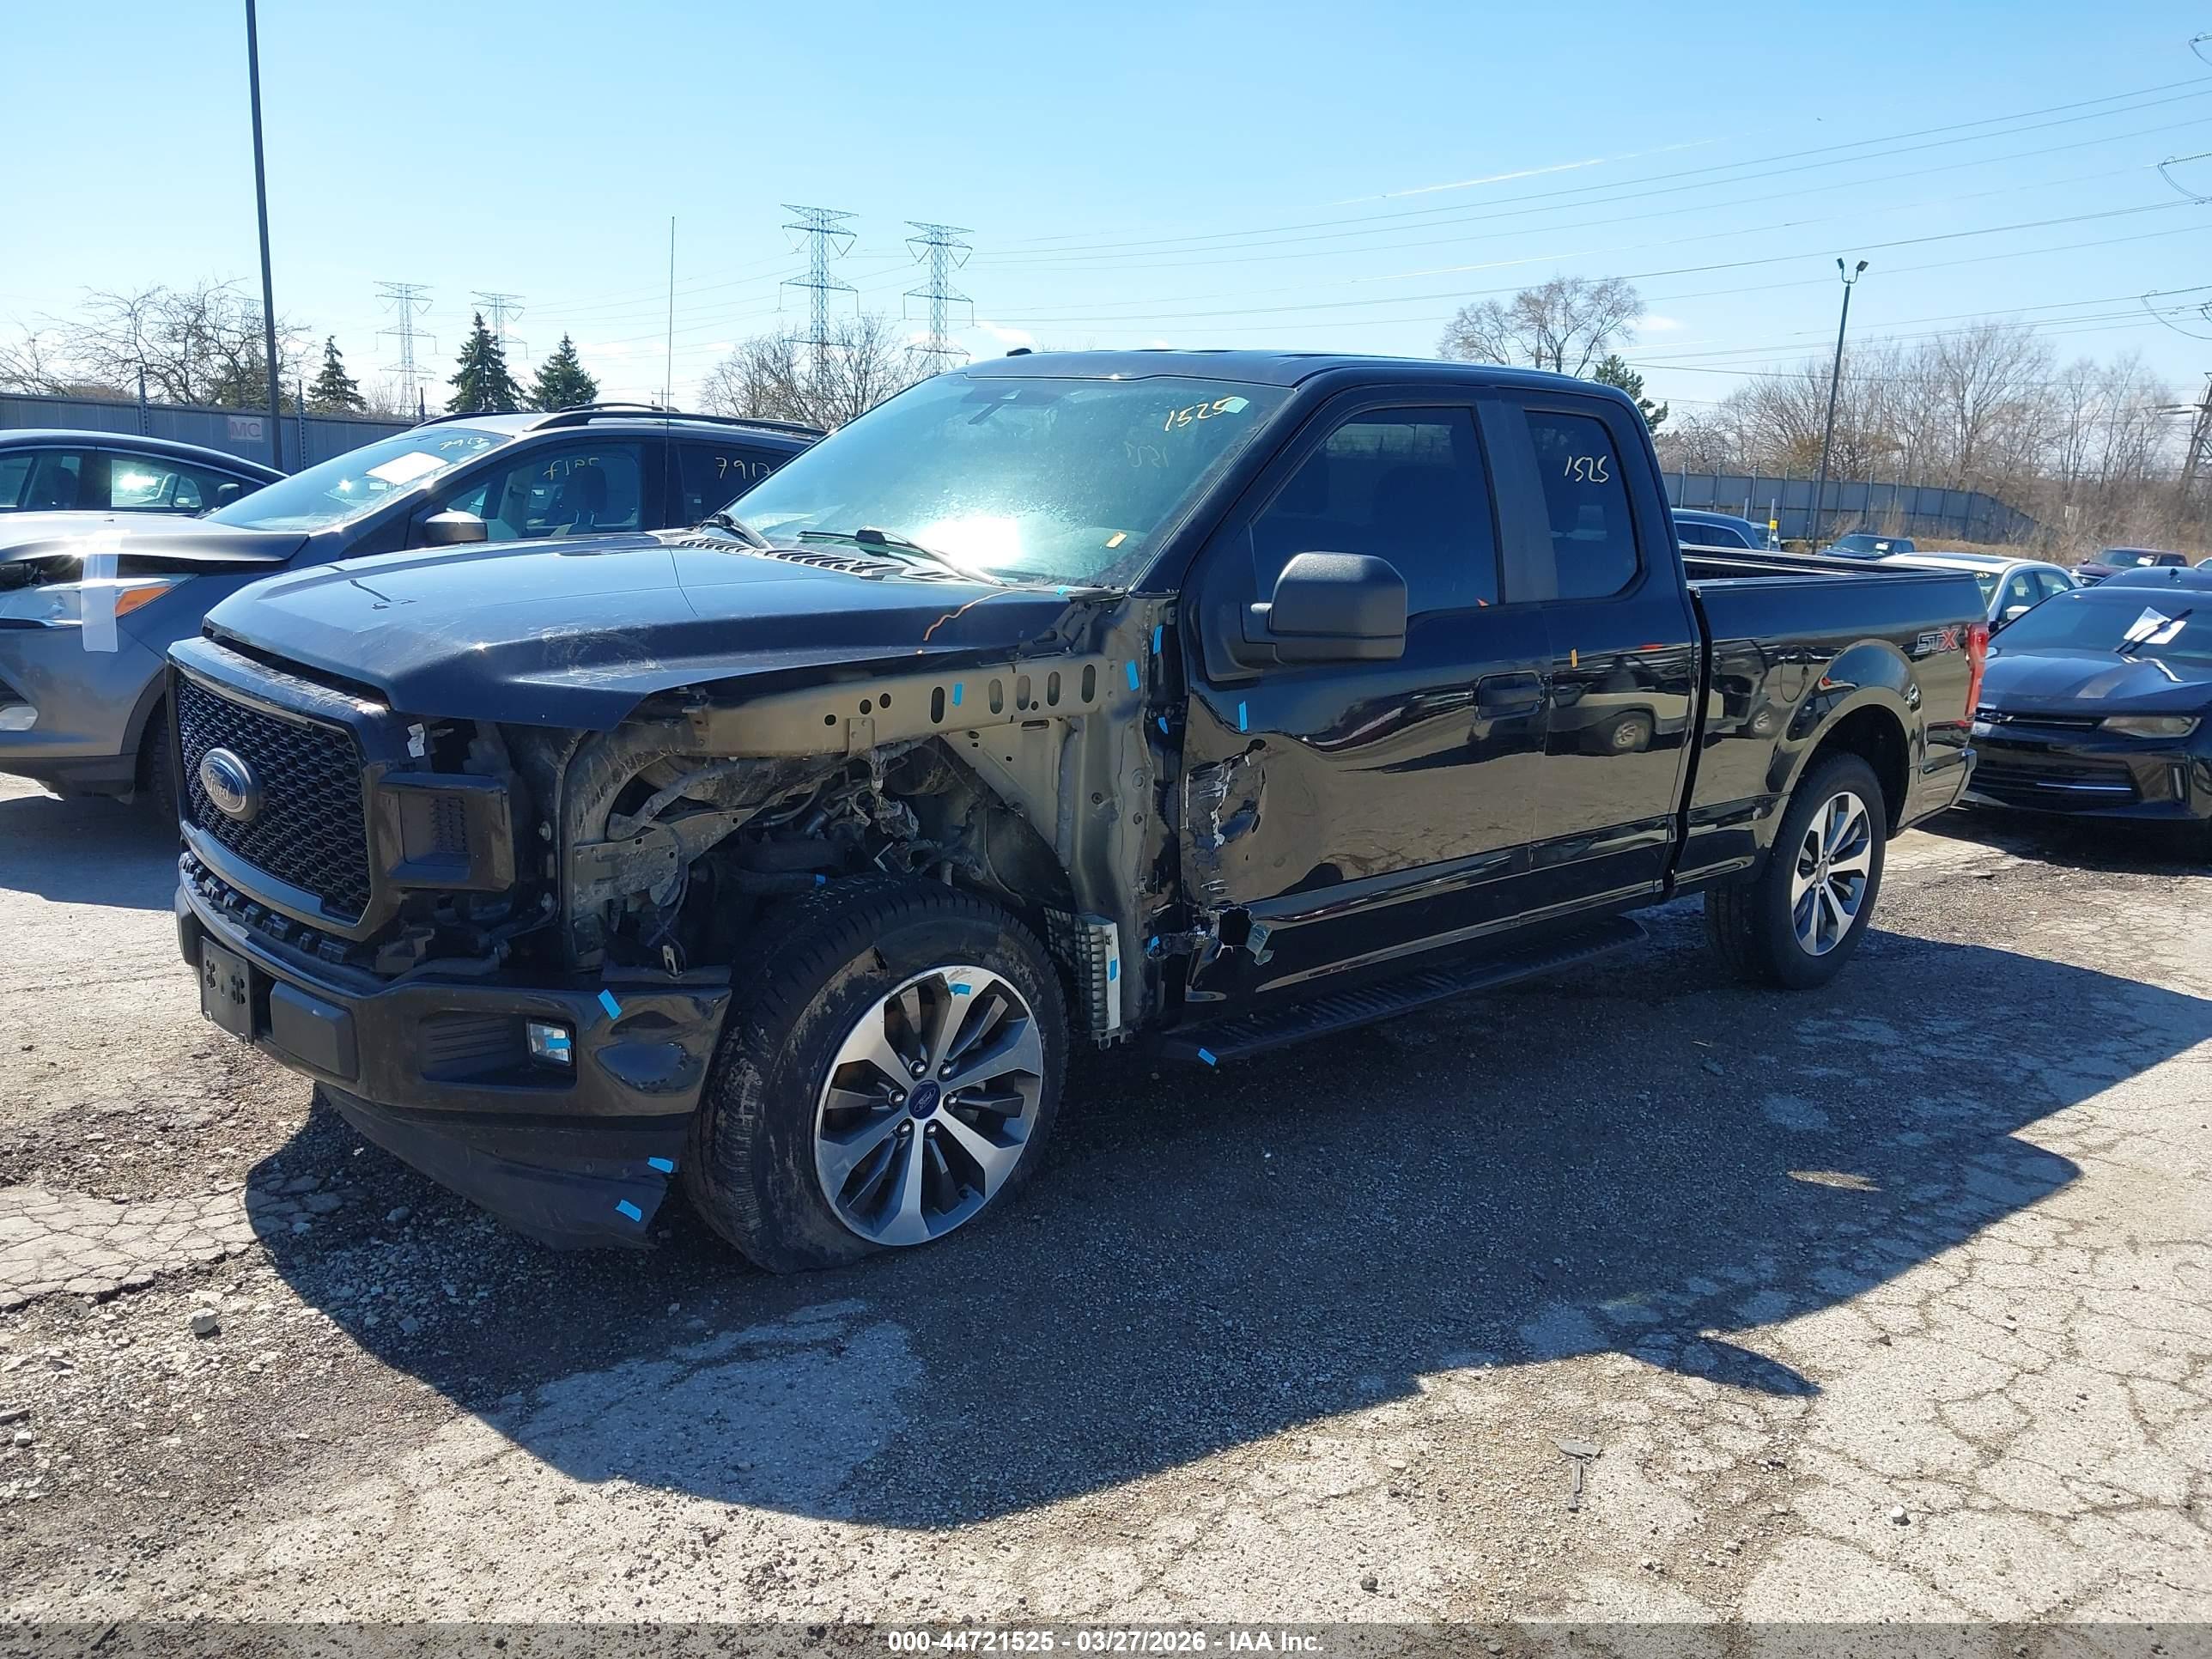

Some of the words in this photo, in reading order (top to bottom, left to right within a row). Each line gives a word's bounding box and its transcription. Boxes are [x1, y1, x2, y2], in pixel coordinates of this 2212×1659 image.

[1164, 396, 1240, 432] 1525
[1564, 455, 1609, 483] 1525
[1913, 627, 1960, 656] STX
